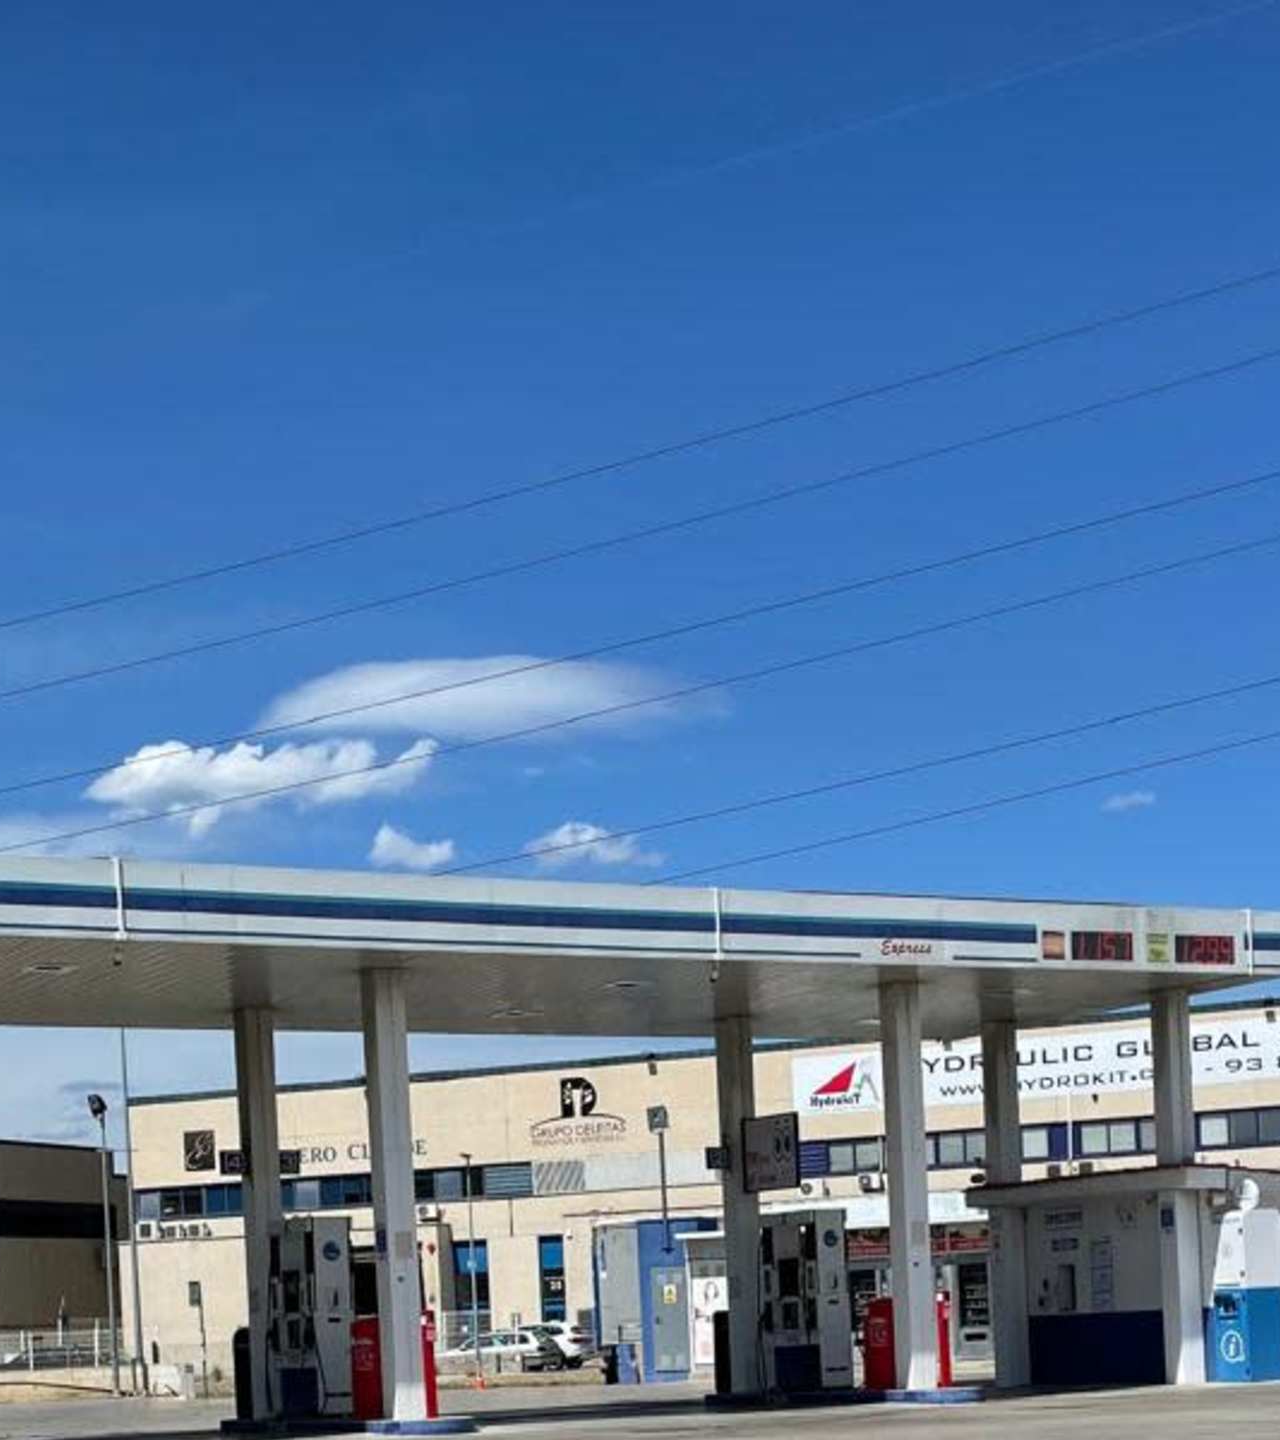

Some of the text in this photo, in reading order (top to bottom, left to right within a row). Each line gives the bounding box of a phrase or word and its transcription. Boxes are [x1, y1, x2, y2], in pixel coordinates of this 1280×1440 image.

[880, 939, 932, 956] Express
[1116, 1030, 1261, 1058] GLBAL
[1225, 1058, 1263, 1073] 93
